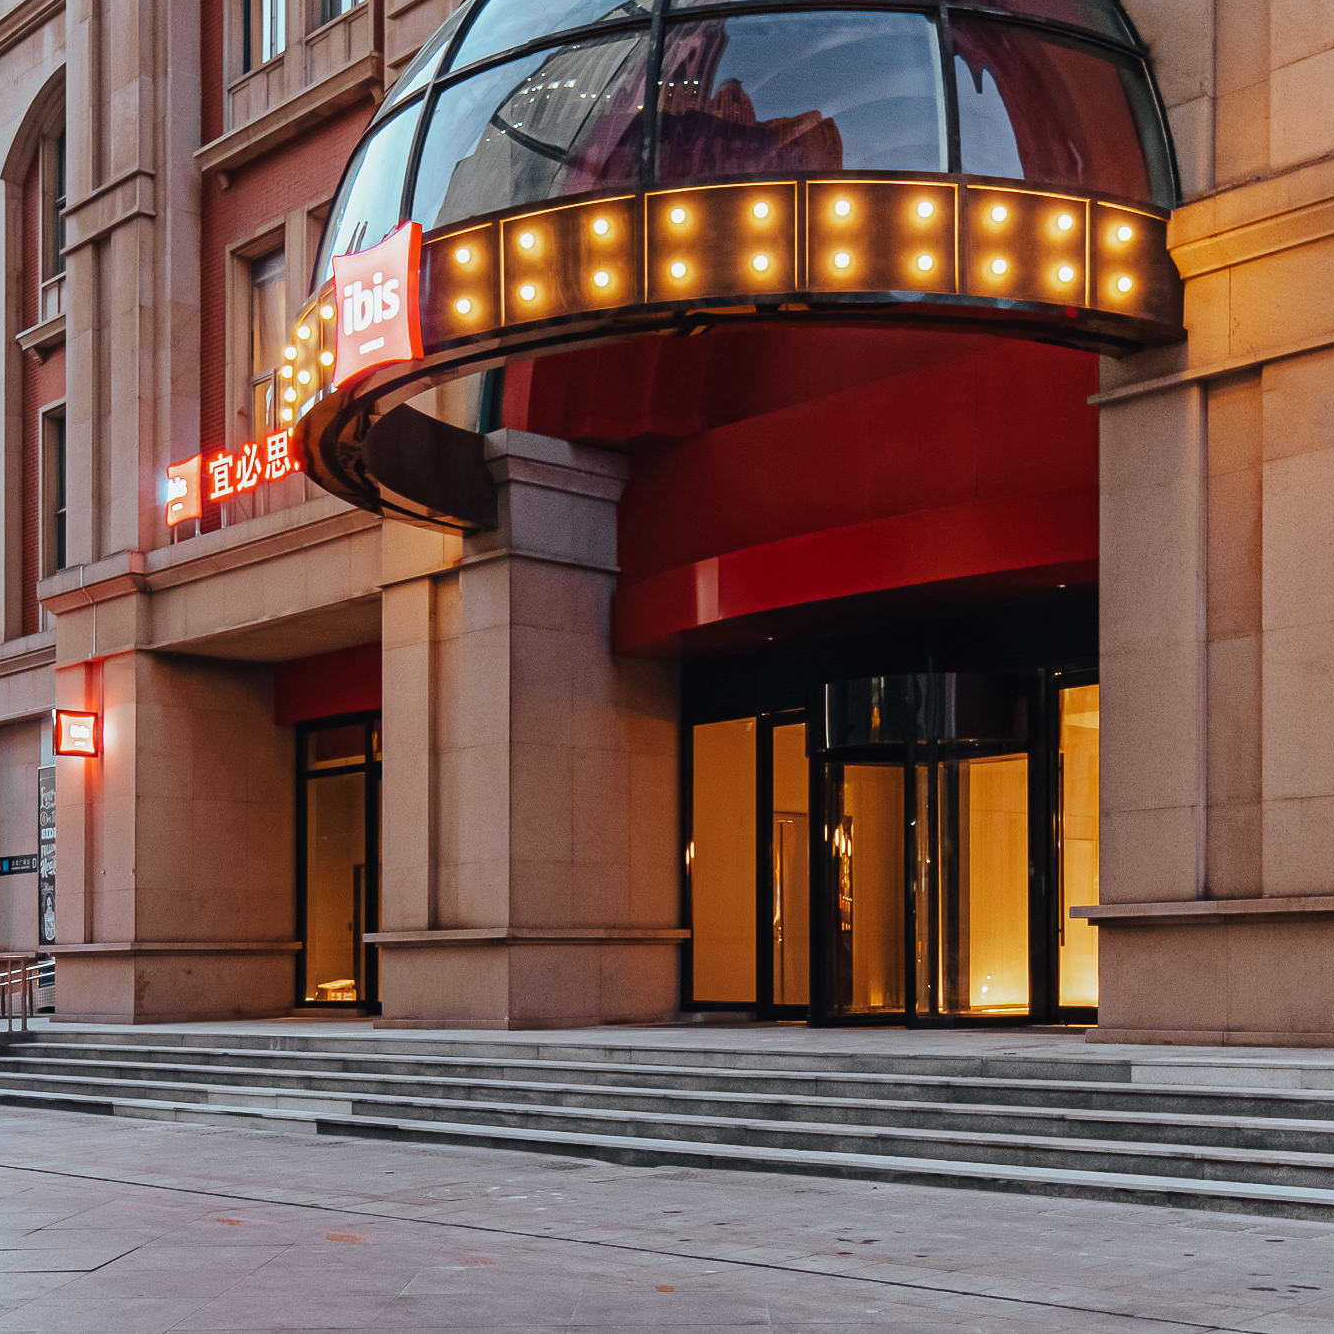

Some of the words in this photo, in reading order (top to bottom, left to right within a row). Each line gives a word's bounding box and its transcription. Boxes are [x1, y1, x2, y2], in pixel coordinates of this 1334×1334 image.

[343, 271, 400, 336] ibis
[209, 430, 299, 500] 宜必思
